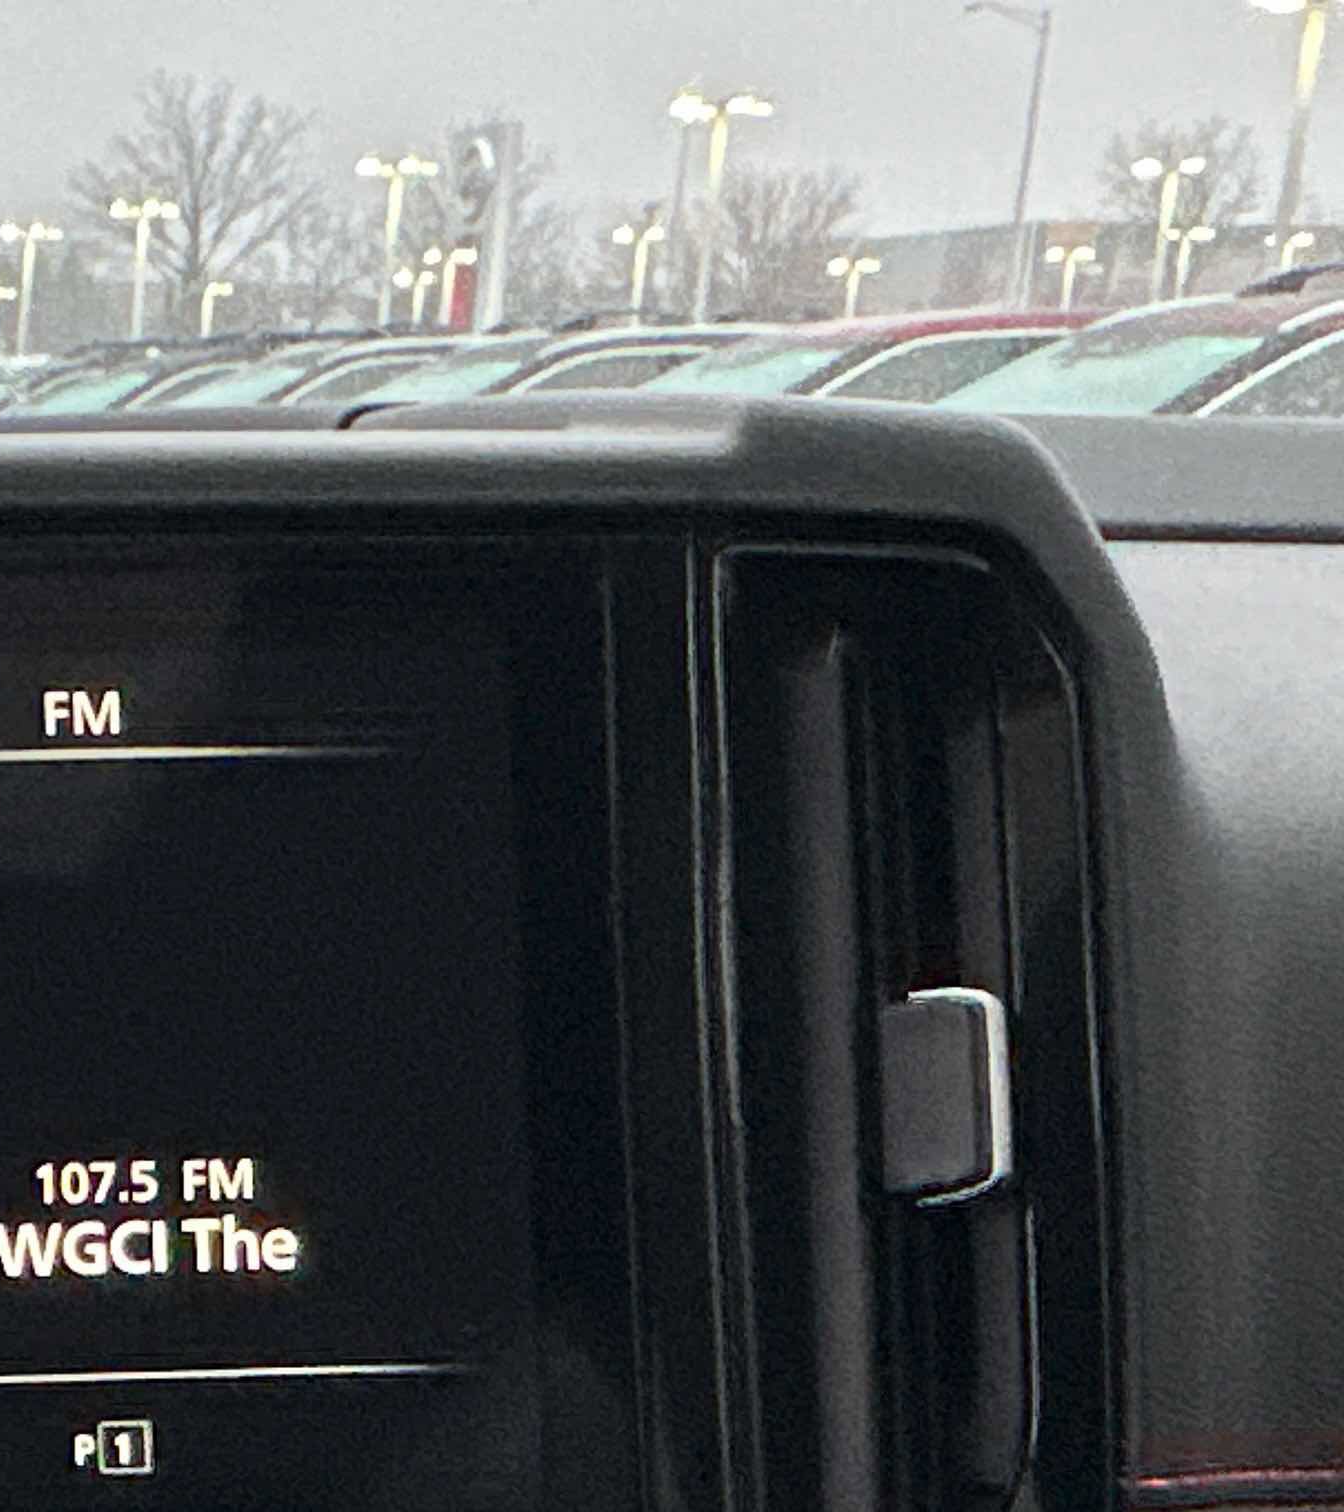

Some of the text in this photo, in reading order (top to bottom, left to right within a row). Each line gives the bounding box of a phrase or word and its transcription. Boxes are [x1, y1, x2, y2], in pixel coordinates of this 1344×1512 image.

[43, 690, 121, 737] FM
[35, 1159, 255, 1205] 107.5 FM
[181, 1214, 298, 1272] The
